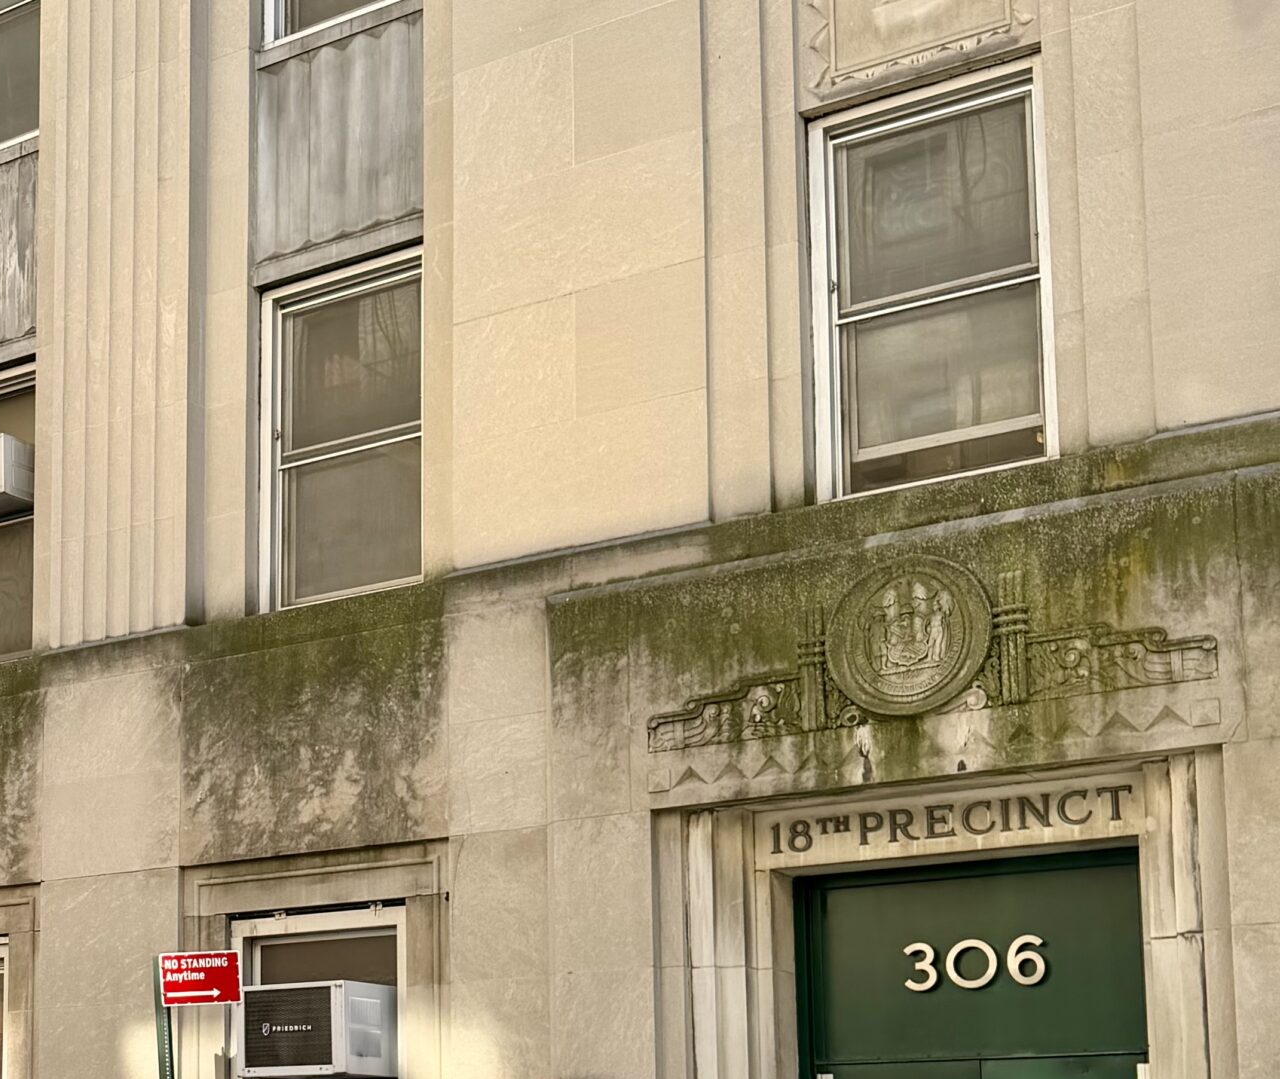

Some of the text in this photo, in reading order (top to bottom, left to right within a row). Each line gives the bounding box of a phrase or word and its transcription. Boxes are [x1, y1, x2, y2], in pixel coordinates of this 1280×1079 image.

[858, 785, 1132, 847] PRECINCT
[164, 957, 228, 970] NO STANDING
[903, 934, 1047, 992] 306
[166, 971, 205, 983] Anytime
[272, 1023, 312, 1032] FRIEDRICH
